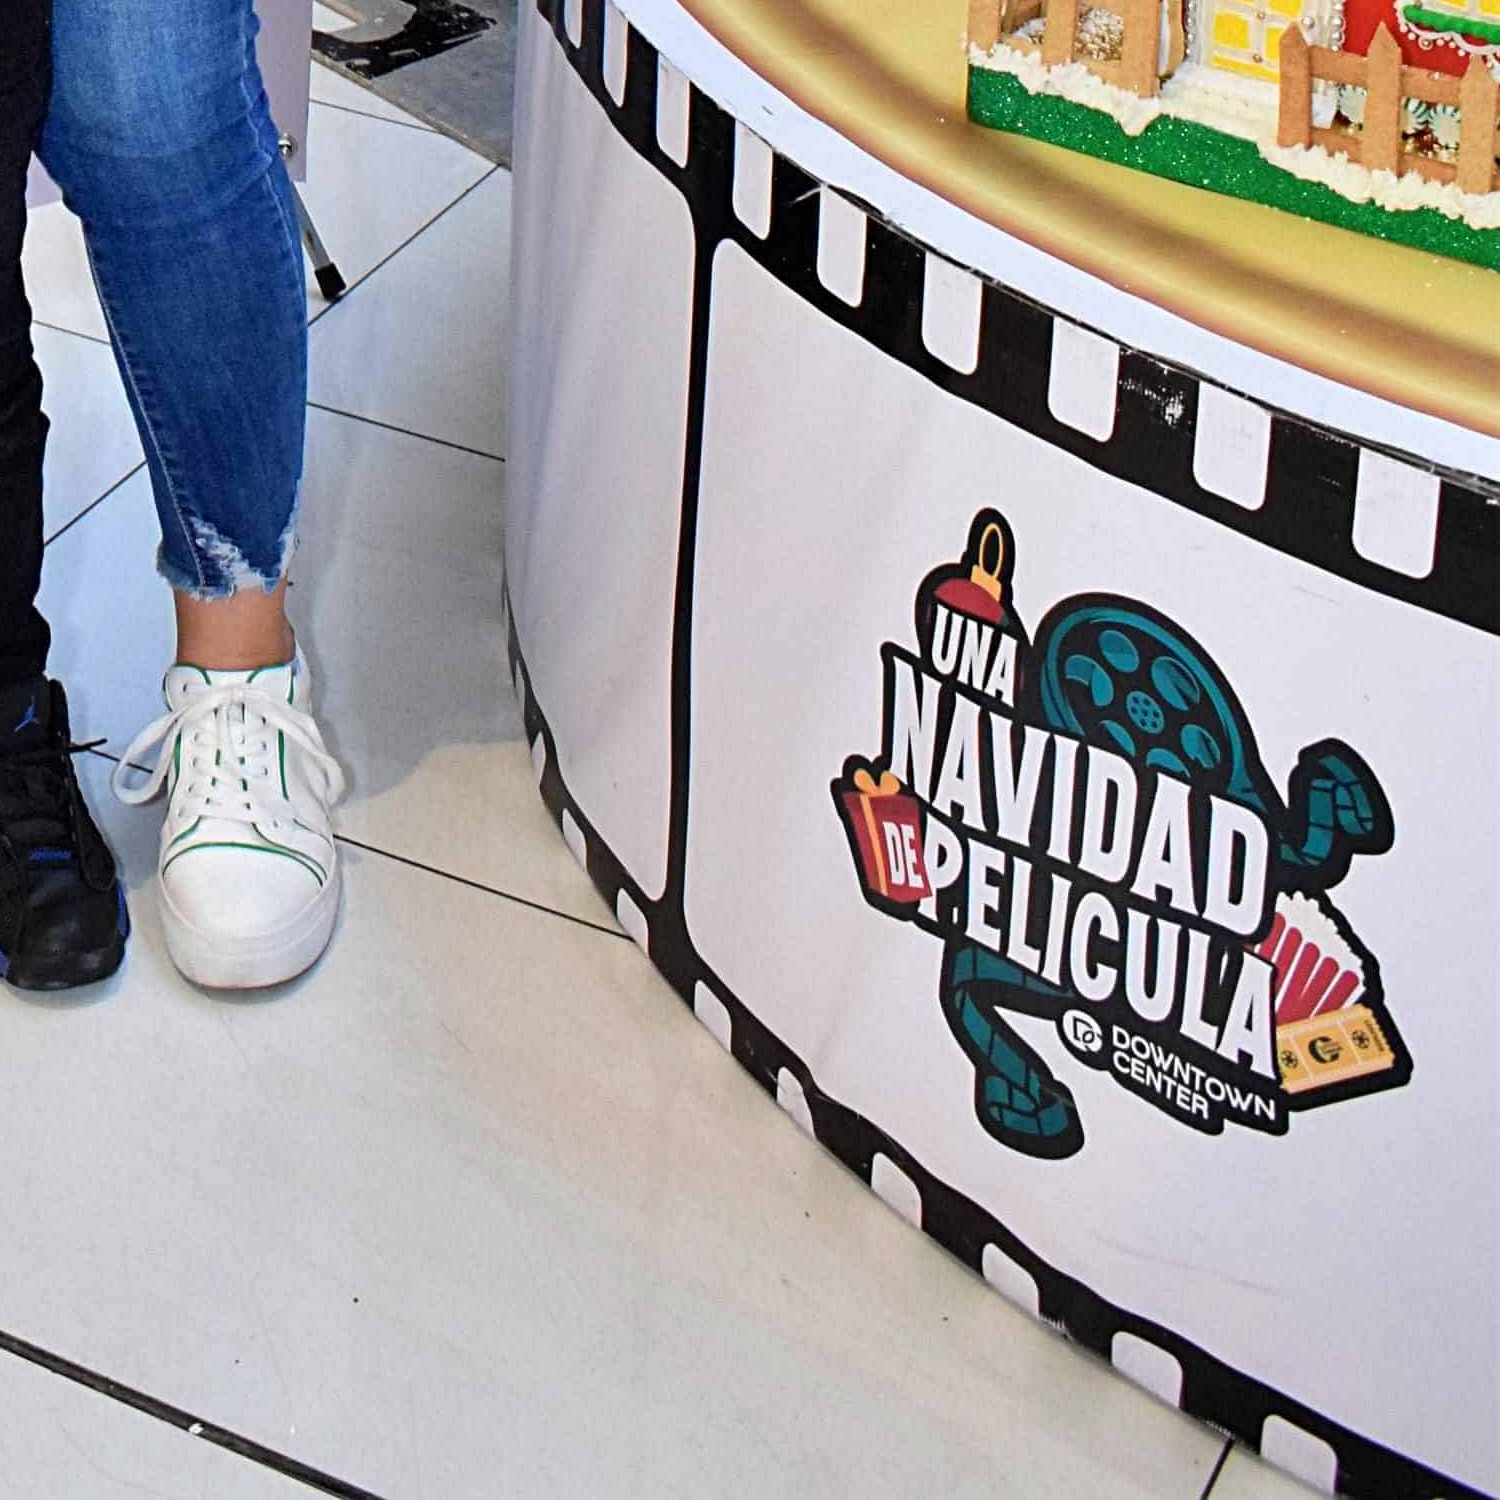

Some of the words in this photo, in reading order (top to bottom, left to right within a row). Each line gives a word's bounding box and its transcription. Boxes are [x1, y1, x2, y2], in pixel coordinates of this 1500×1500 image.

[930, 604, 1019, 709] UNA
[890, 655, 1270, 938] NAVIDAD
[882, 820, 924, 890] DE
[919, 814, 1278, 1080] PELICULA
[1112, 1025, 1276, 1121] DOWNTOWN
[1112, 1051, 1210, 1120] CENTER
